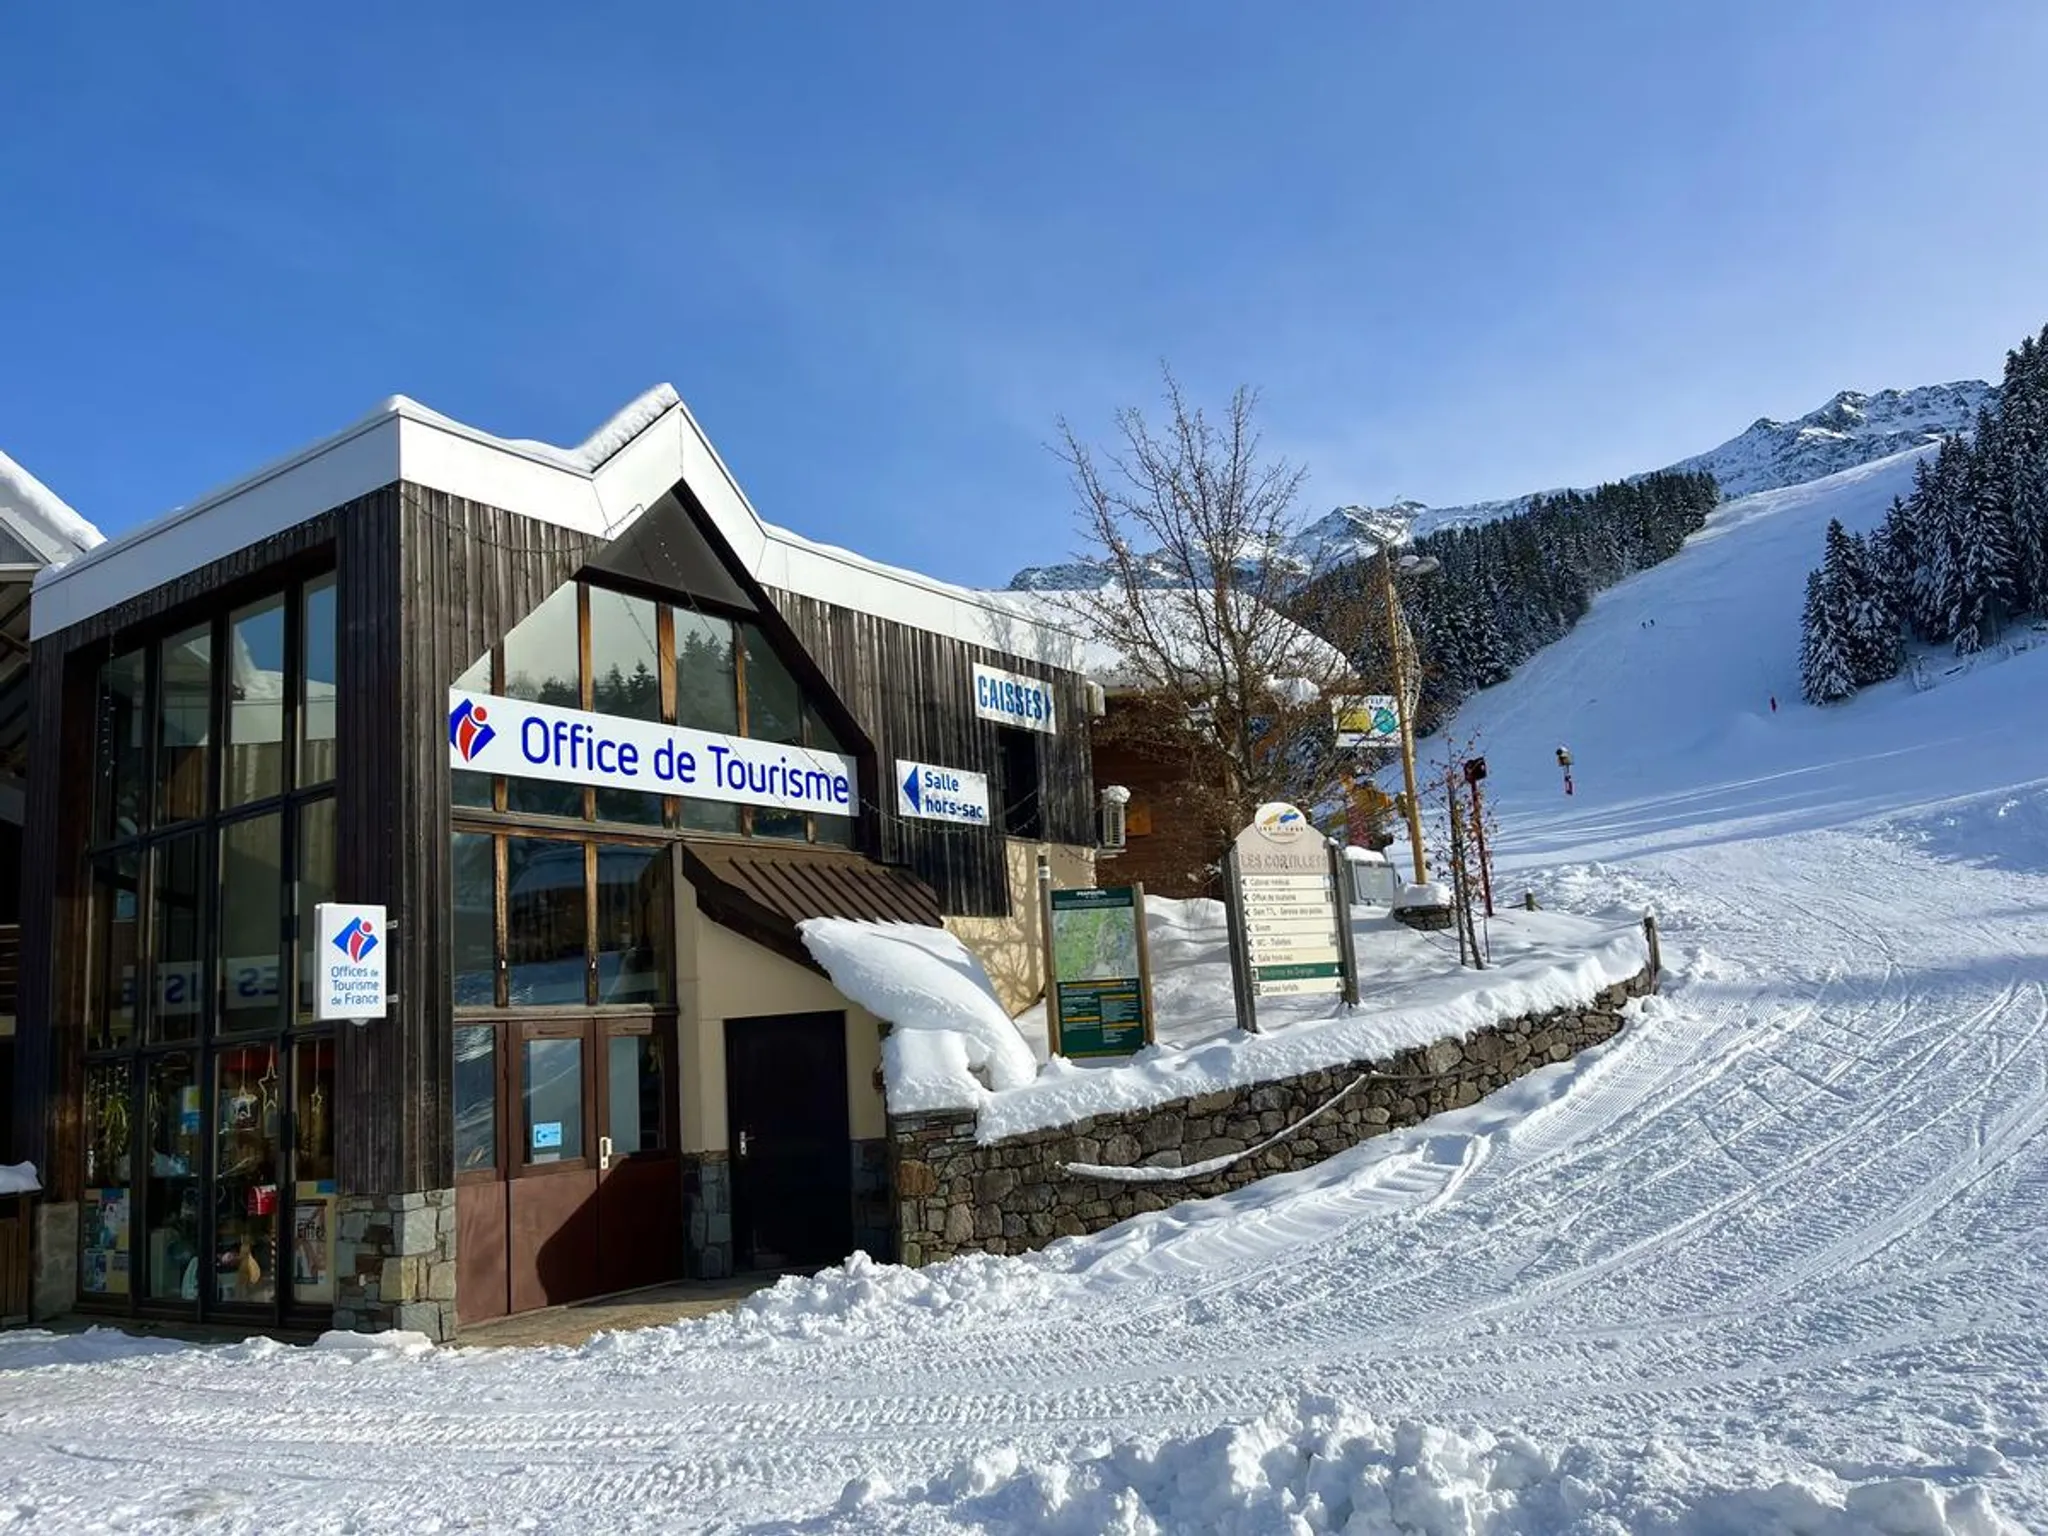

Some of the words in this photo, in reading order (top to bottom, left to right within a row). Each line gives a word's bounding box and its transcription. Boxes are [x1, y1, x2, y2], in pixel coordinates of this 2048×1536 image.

[977, 675, 1042, 720] CAISSES
[521, 716, 639, 776] Office
[654, 738, 696, 784] de
[707, 745, 849, 804] Tourisme
[924, 771, 959, 792] Salle
[926, 796, 983, 818] hors-sac
[331, 966, 368, 978] Offices
[332, 980, 379, 991] Tourisme
[331, 996, 342, 1005] de
[344, 994, 379, 1004] France
